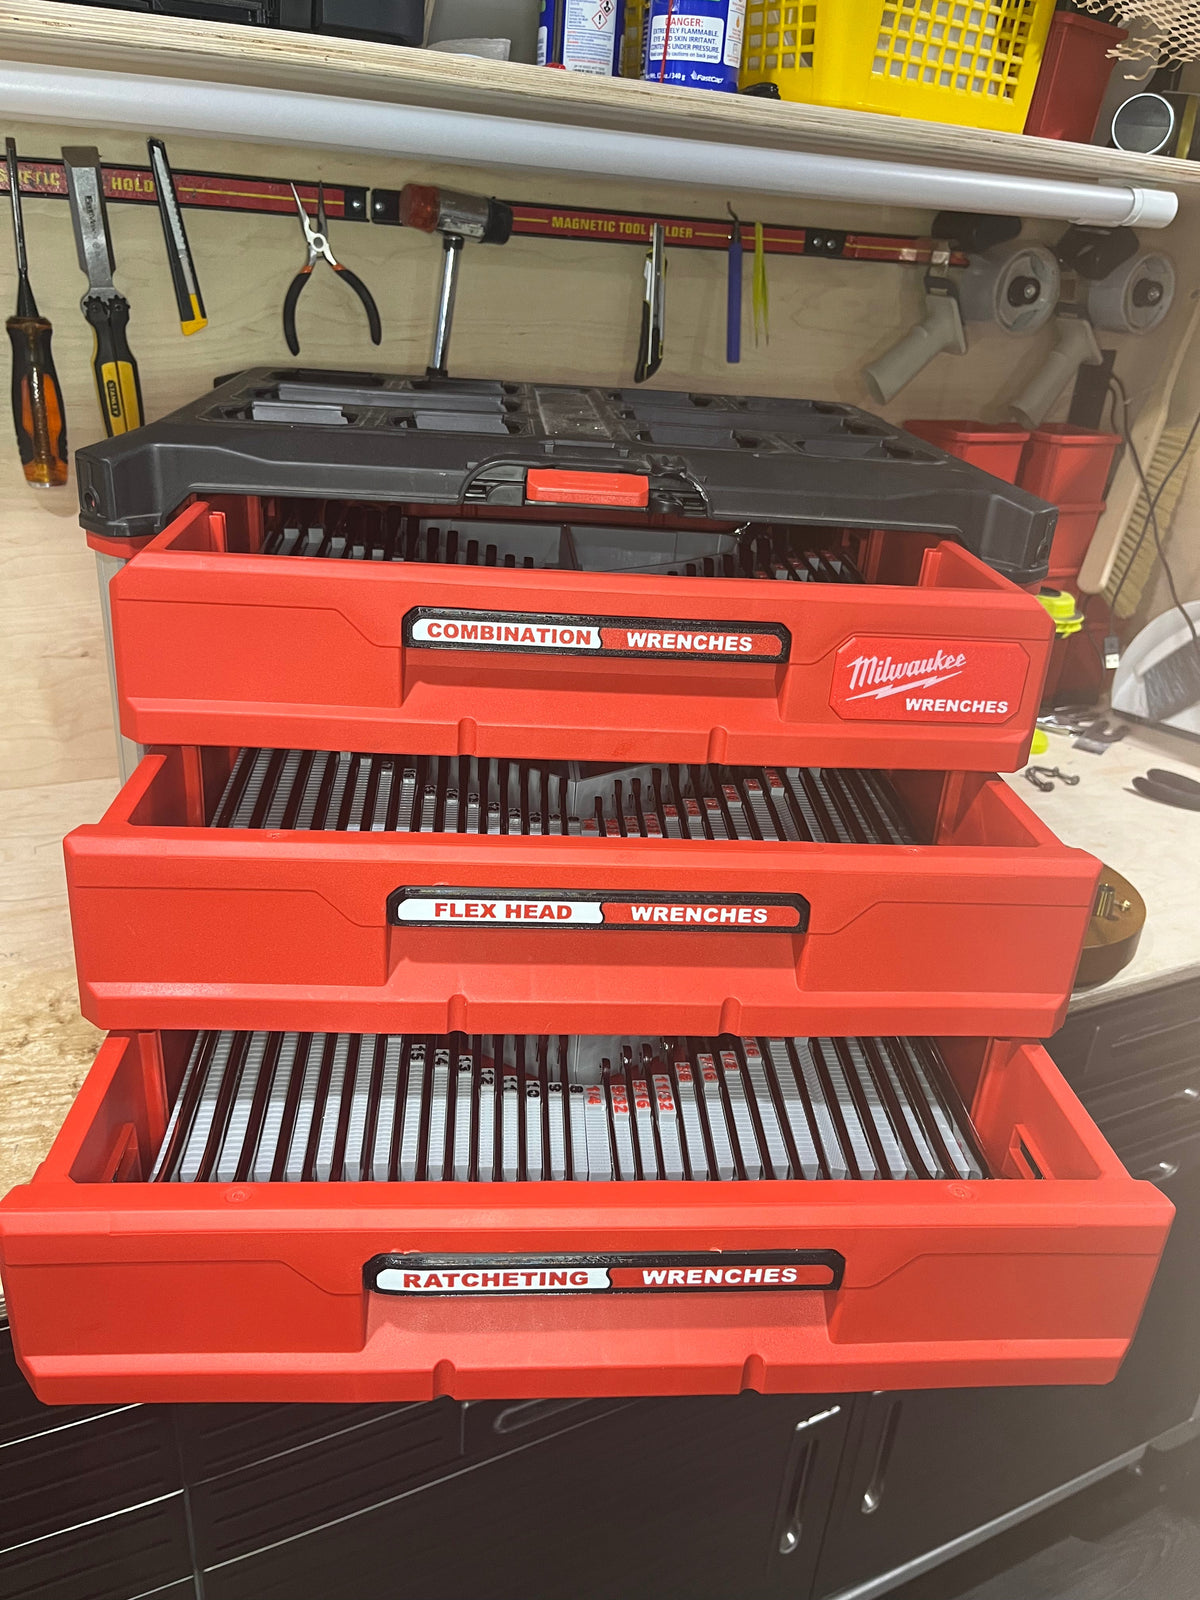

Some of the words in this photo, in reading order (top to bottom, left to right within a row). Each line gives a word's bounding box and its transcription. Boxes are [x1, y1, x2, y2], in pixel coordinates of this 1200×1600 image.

[697, 74, 724, 84] FastCap
[111, 177, 154, 192] HOLD
[552, 216, 616, 232] MAGNETIC
[619, 222, 647, 235] TOOL
[109, 381, 119, 415] STANLEY
[427, 622, 592, 645] COMBINATION
[627, 631, 753, 652] WRENCHES
[846, 649, 967, 690] Milwaukee
[905, 698, 1009, 713] WRENCHES
[434, 903, 497, 918] FLEX
[505, 904, 573, 919] HEAD
[631, 907, 768, 923] WRENCHES
[410, 1045, 426, 1060] 15
[435, 1051, 449, 1065] 14
[460, 1057, 472, 1072] 13
[676, 1063, 692, 1082] 3/8
[699, 1055, 718, 1080] 7/16
[480, 1070, 494, 1085] 12
[503, 1077, 518, 1092] 11
[526, 1082, 540, 1098] 10
[586, 1085, 602, 1104] 1/4
[632, 1081, 651, 1109] 5/16
[655, 1076, 675, 1111] 11/32
[611, 1086, 629, 1114] 9/32
[403, 1271, 589, 1289] RATCHETING
[642, 1268, 798, 1285] WRENCHES
